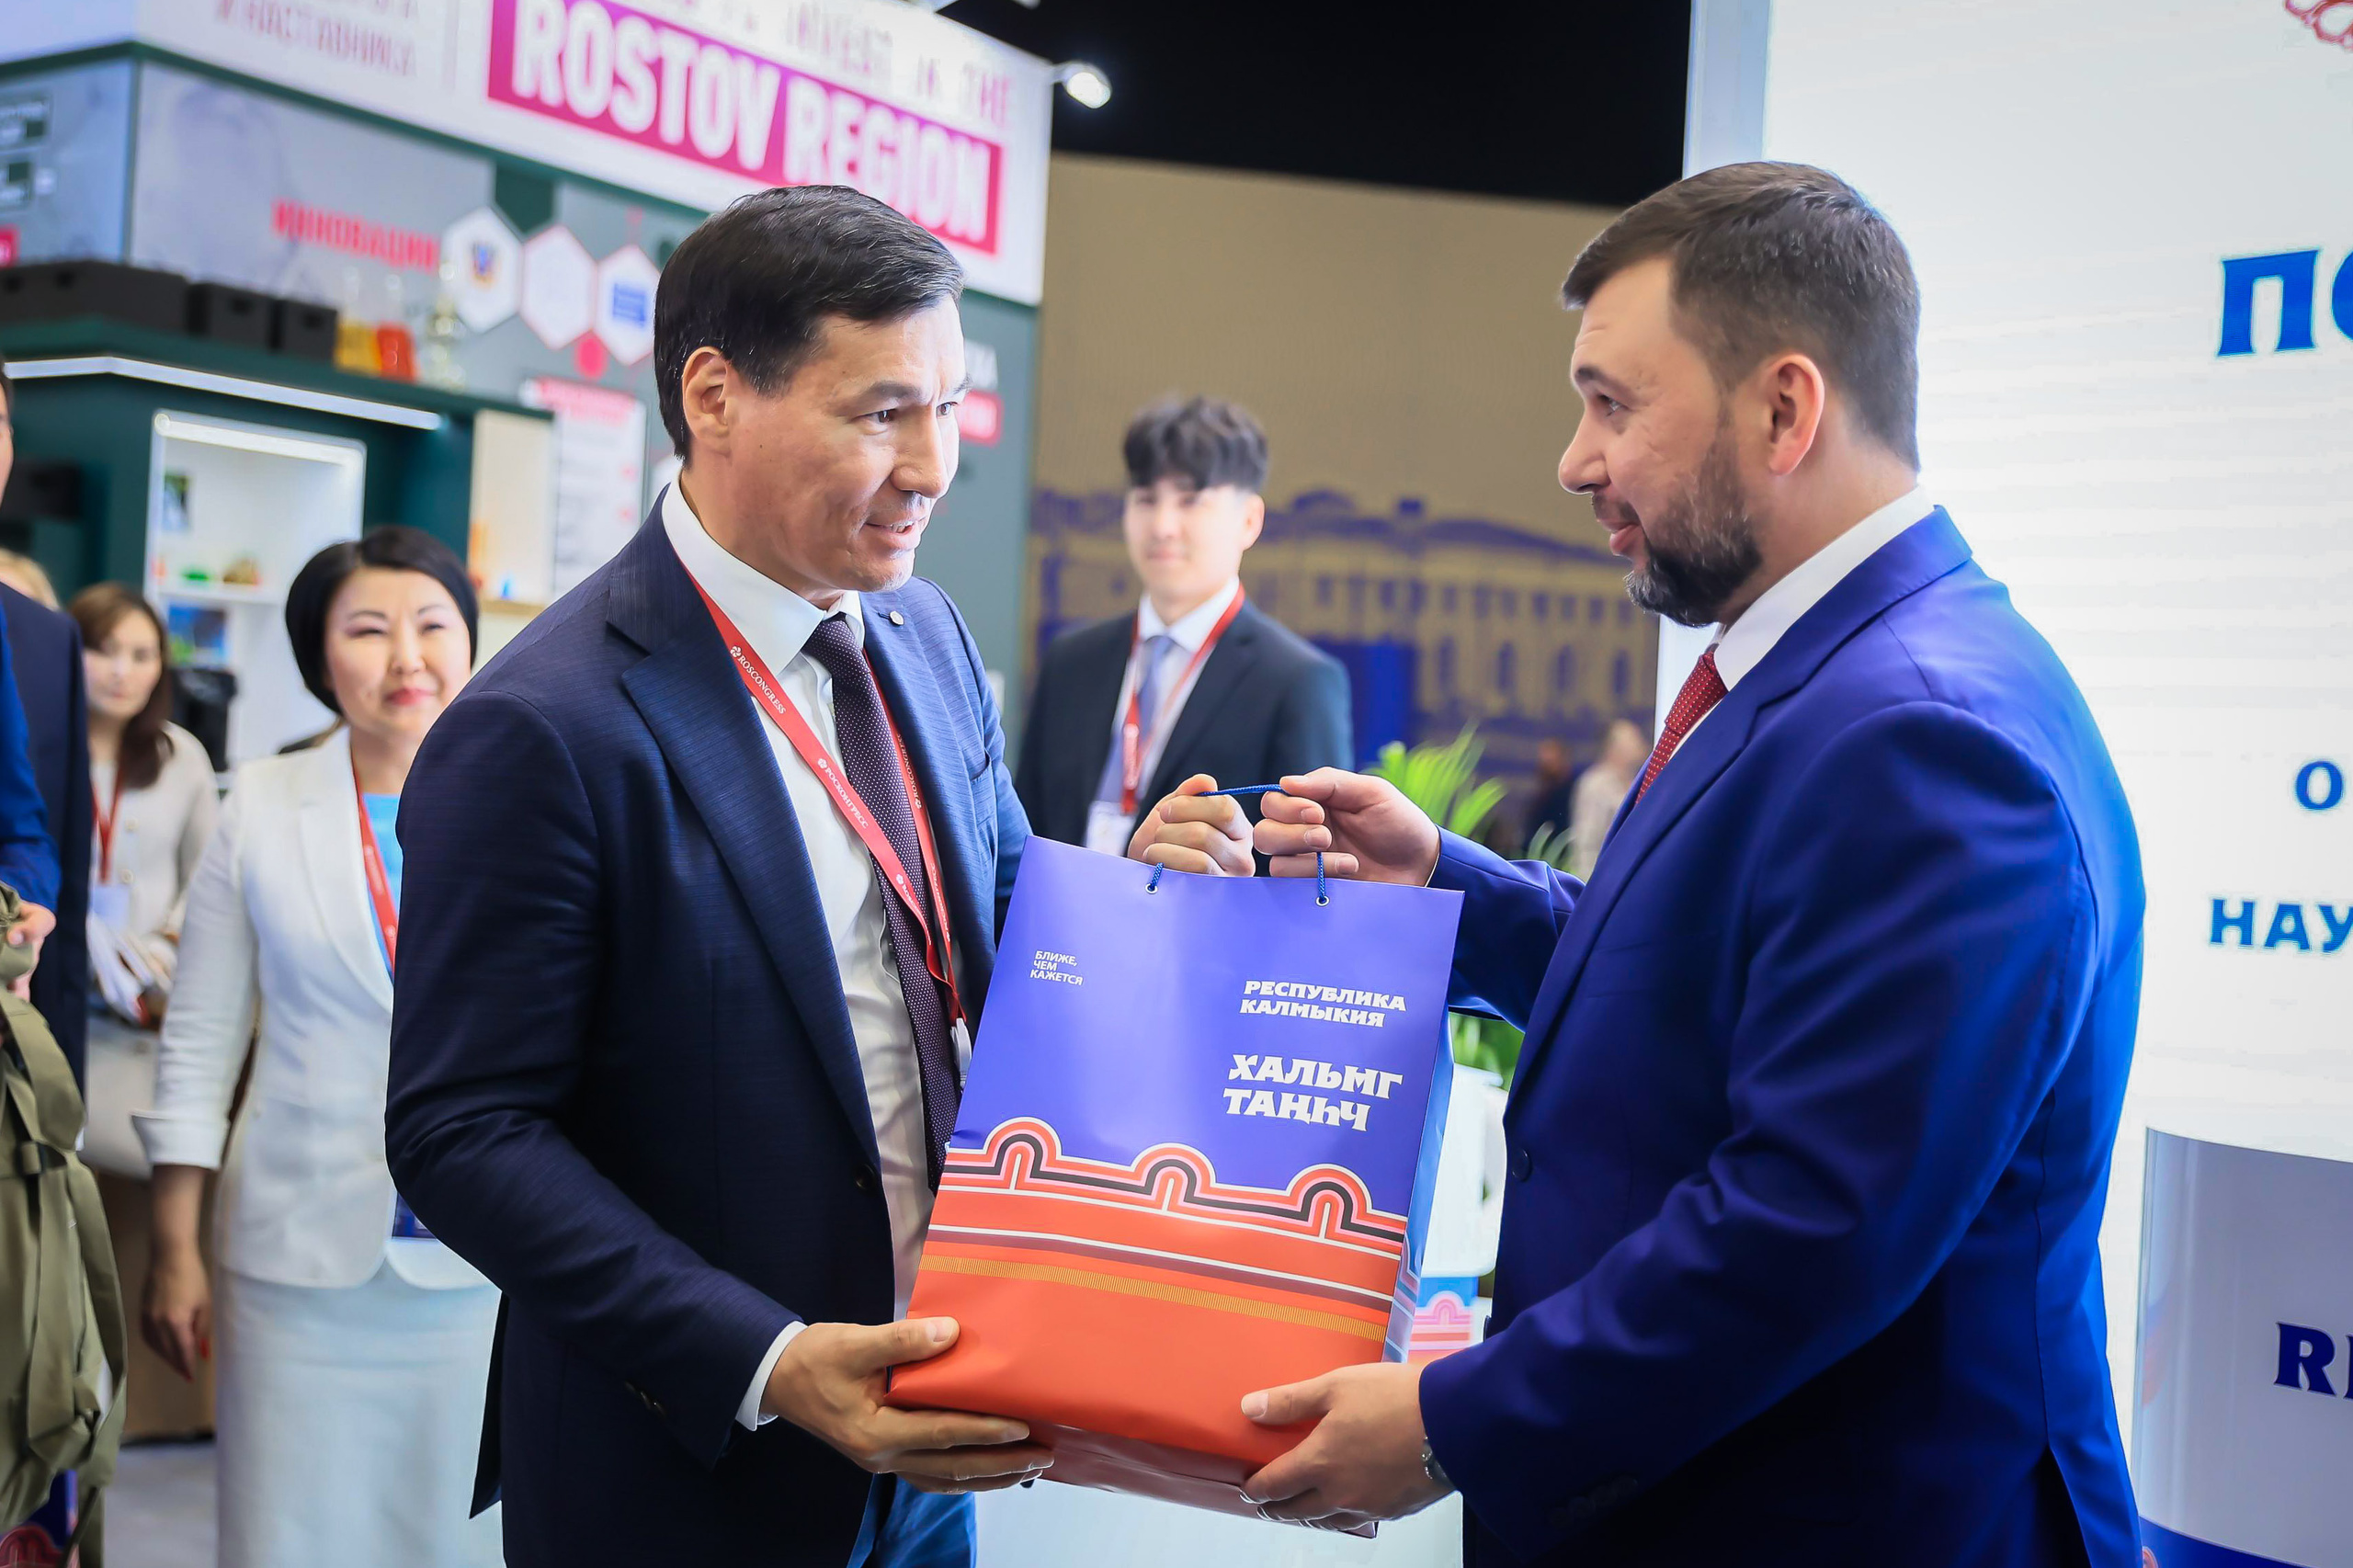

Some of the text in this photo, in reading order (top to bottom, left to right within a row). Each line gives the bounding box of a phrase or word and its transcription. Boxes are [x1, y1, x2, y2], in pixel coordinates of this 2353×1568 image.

[512, 0, 989, 243] ROSTOV REGION
[959, 61, 1010, 131] THE
[271, 196, 441, 275] ИННОВАЦИИ
[2217, 249, 2353, 357] П
[737, 654, 787, 715] ROSCONGRESS
[824, 767, 870, 829] РОСКОНГРЕСС
[1029, 969, 1084, 986] КАЖЕТСЯ
[1033, 960, 1058, 971] ЧЕМ
[1034, 950, 1077, 967] БЛИЖЕ,
[1240, 999, 1386, 1028] КАЛМЫКИЯ
[1244, 980, 1407, 1011] РЕСПУБЛИКА
[1228, 1054, 1404, 1099] ХАЛЬМГ
[2273, 1322, 2353, 1400] R
